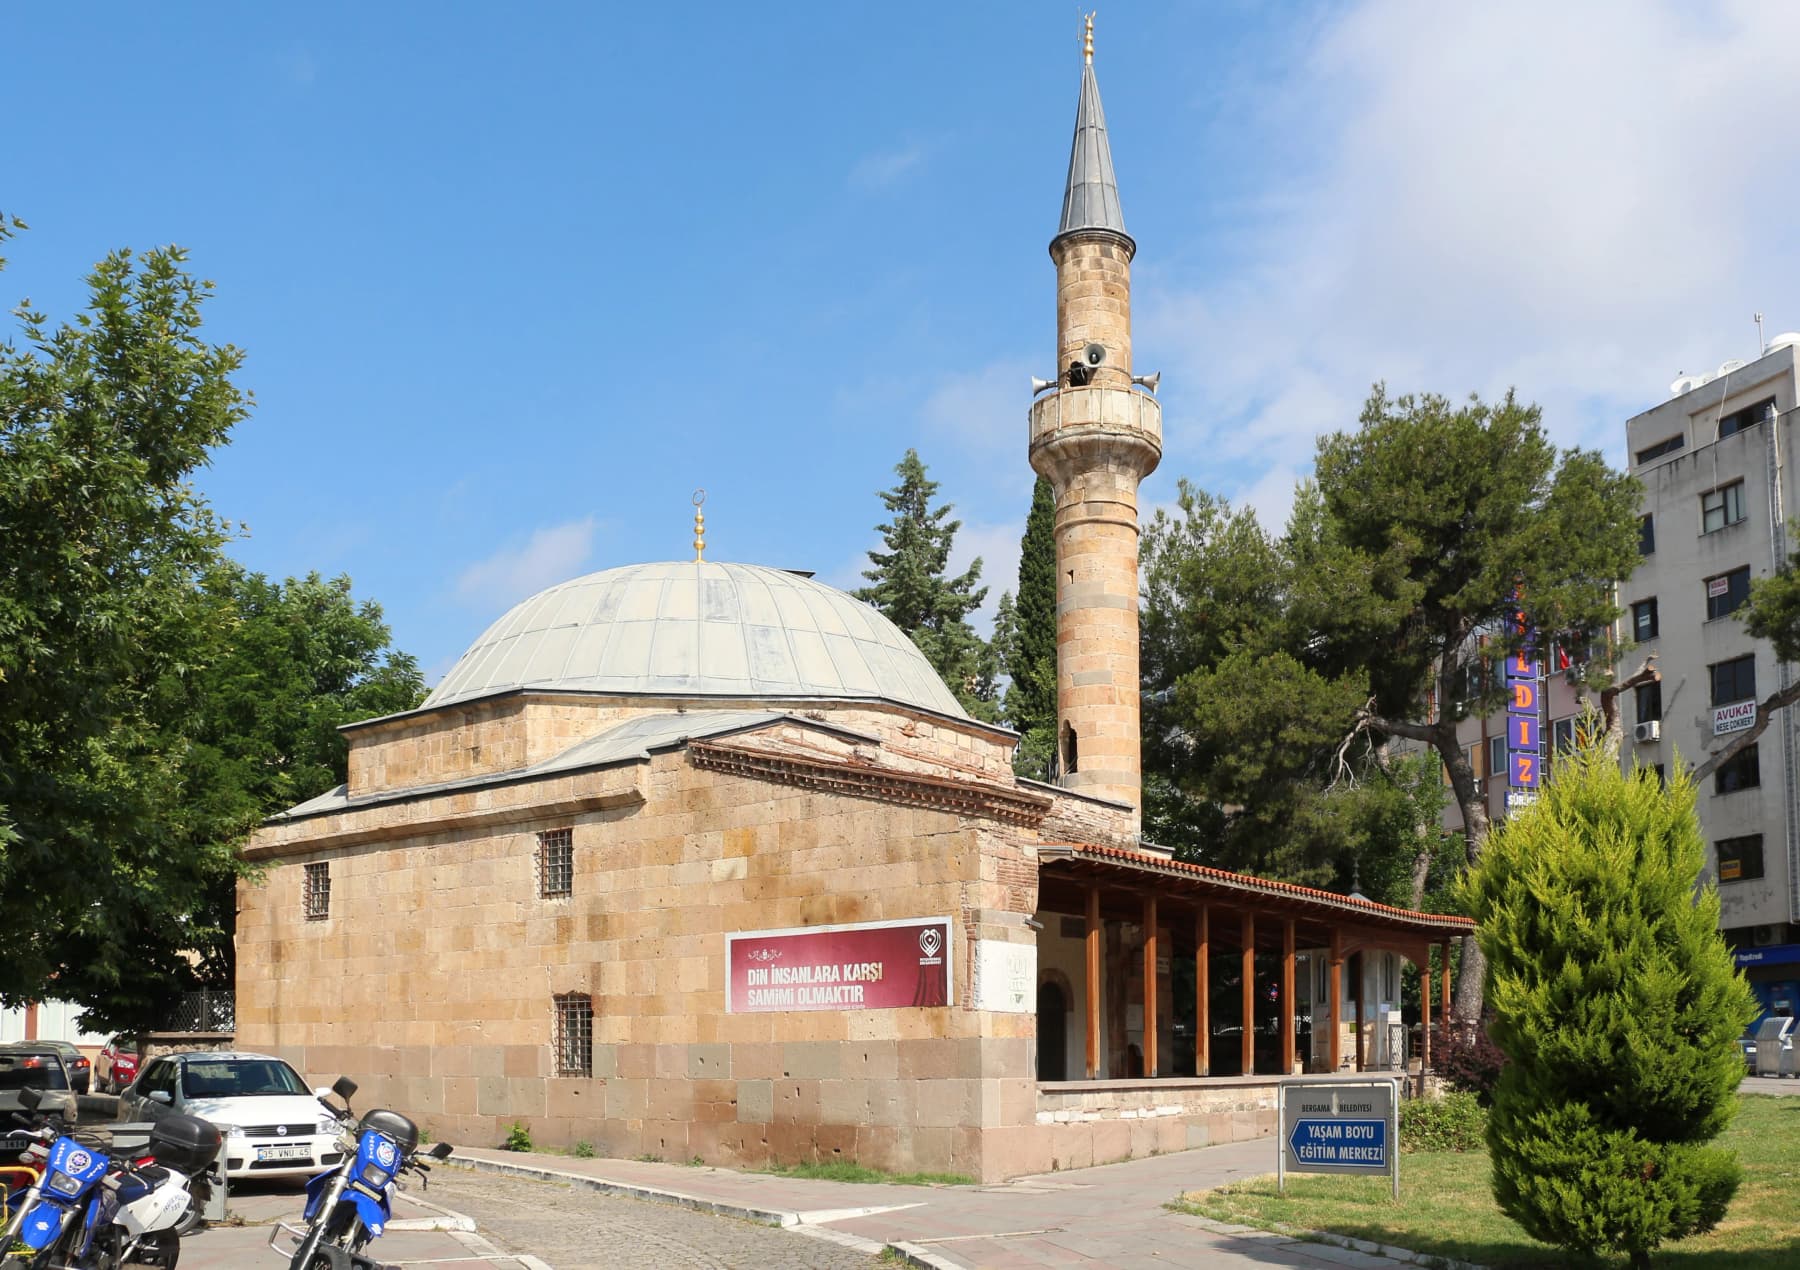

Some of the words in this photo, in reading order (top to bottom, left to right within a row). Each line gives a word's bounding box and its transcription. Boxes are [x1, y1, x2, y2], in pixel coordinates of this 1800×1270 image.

[1716, 703, 1754, 721] AVUKAT
[771, 964, 841, 985] İNSANLARA
[843, 962, 883, 982] KARŞI
[798, 985, 864, 1004] OLMAKTIR
[1302, 1104, 1330, 1113] BERGAMA
[1308, 1125, 1342, 1142] YAŞAM
[1346, 1126, 1374, 1139] BOYU
[1300, 1142, 1336, 1159] EĞİTİM
[1339, 1144, 1383, 1161] MERKEZİ
